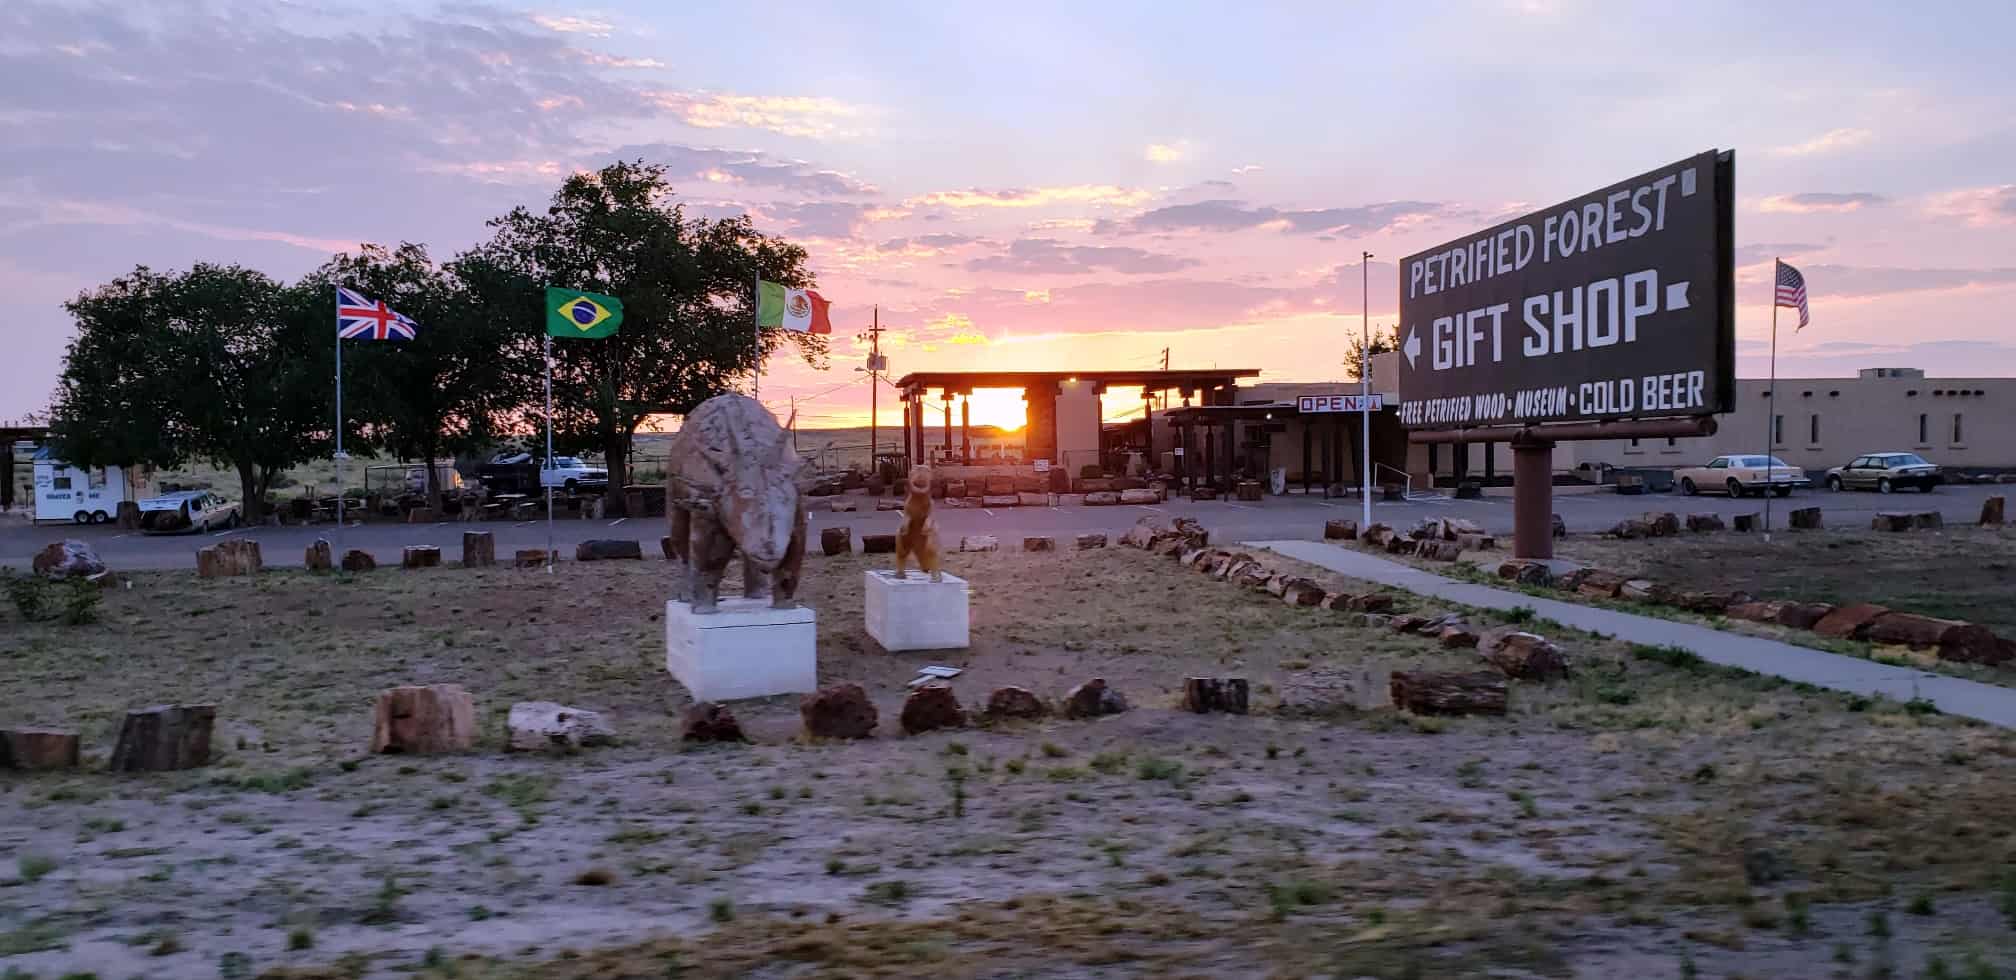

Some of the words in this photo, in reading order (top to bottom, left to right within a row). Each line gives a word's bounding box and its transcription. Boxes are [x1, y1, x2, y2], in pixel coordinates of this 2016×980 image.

[1410, 224, 1534, 299] PETRIFIED
[1543, 174, 1677, 263] FOREST
[1432, 303, 1509, 371] GIFT
[1523, 269, 1658, 357] SHOP
[1302, 397, 1357, 411] OPEN
[1401, 400, 1422, 424] FREE
[1425, 395, 1471, 422] PETRIFIED
[1474, 393, 1505, 419] WOOD
[1514, 386, 1568, 418] MUSEUM
[1579, 378, 1634, 415] COLD
[1642, 370, 1704, 411] BEER
